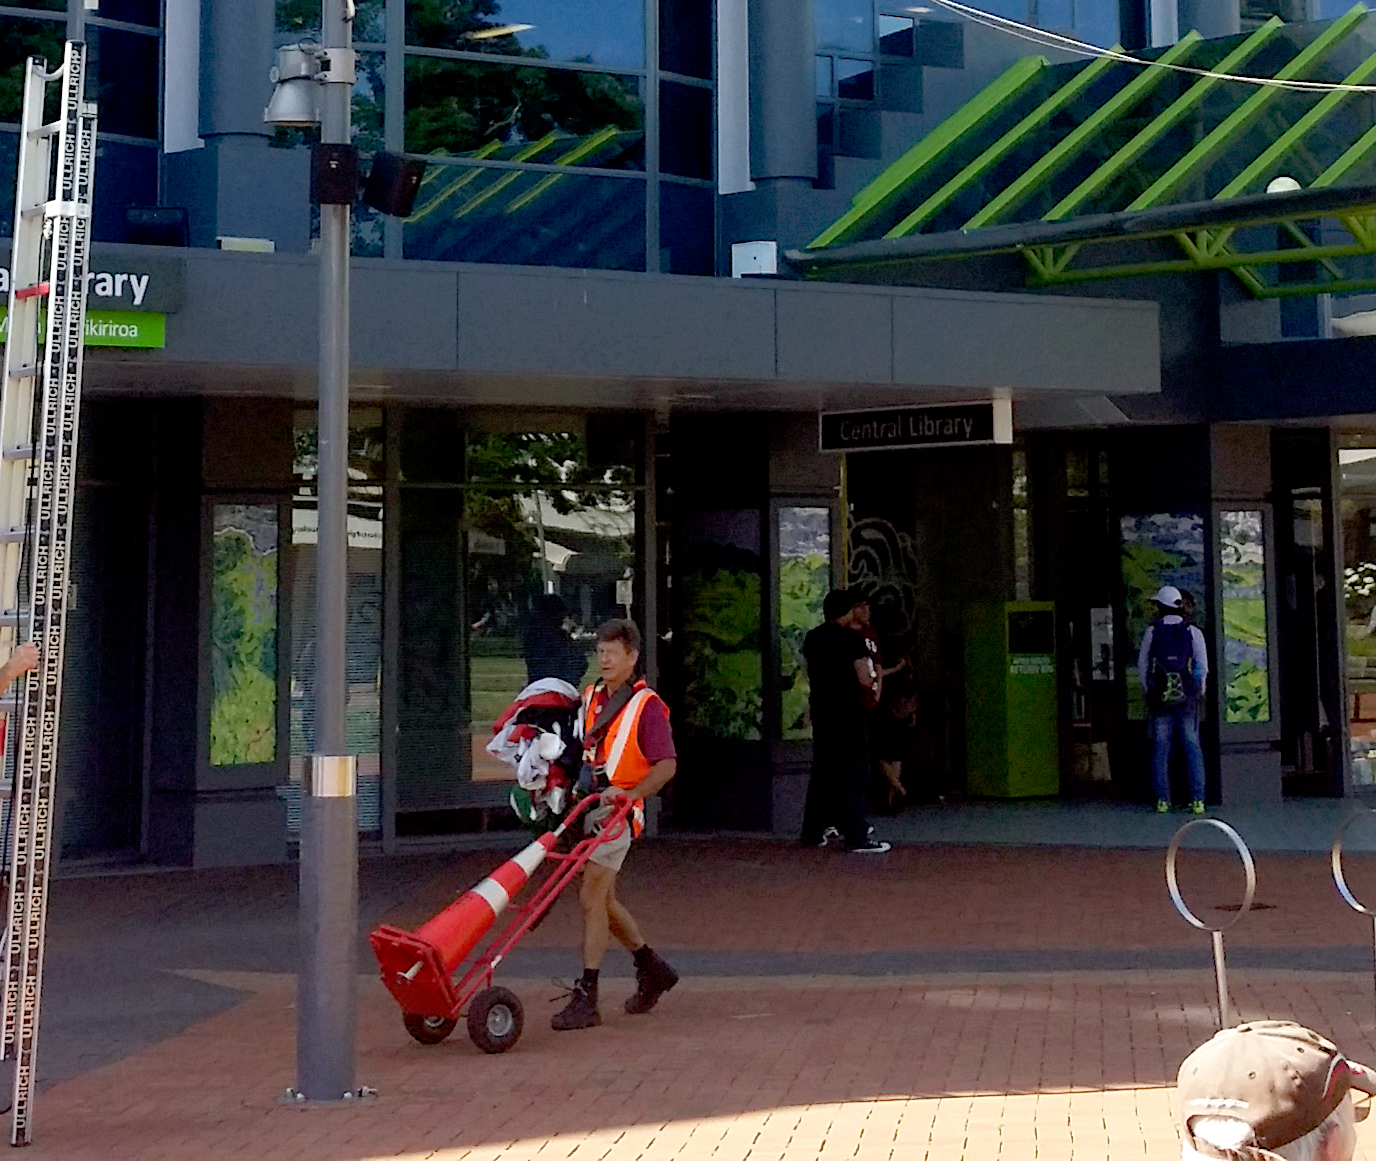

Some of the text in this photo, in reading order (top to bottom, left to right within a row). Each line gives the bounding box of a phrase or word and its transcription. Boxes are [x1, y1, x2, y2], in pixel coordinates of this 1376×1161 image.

[62, 134, 76, 190] ULLRICH
[78, 129, 92, 186] ULLRICH
[74, 217, 87, 267] ULLRIC
[87, 271, 150, 306] rary
[51, 297, 65, 353] ULLRICH
[68, 292, 82, 348] ULLRICH
[84, 318, 138, 337] ikiriroa
[46, 374, 59, 436] ULLRICH
[63, 371, 78, 431] ULLRICH
[840, 414, 974, 441] Central Library
[41, 460, 54, 520] ULLRICH
[58, 457, 72, 515] ULLRICH
[35, 545, 49, 605] ULLRICH
[52, 541, 66, 600] ULLRICH
[47, 625, 61, 686] ULLRICH
[24, 717, 38, 778] ULLRICH
[41, 711, 55, 772] ULLRICH
[17, 804, 31, 866] ULLRICH
[35, 798, 49, 860] ULLRICH
[10, 892, 25, 954] ULLRICH
[28, 887, 43, 949] ULLRICH
[4, 981, 19, 1045] ULLRICH
[22, 975, 37, 1038] ULLRICH
[16, 1065, 30, 1129] ULLRICH
